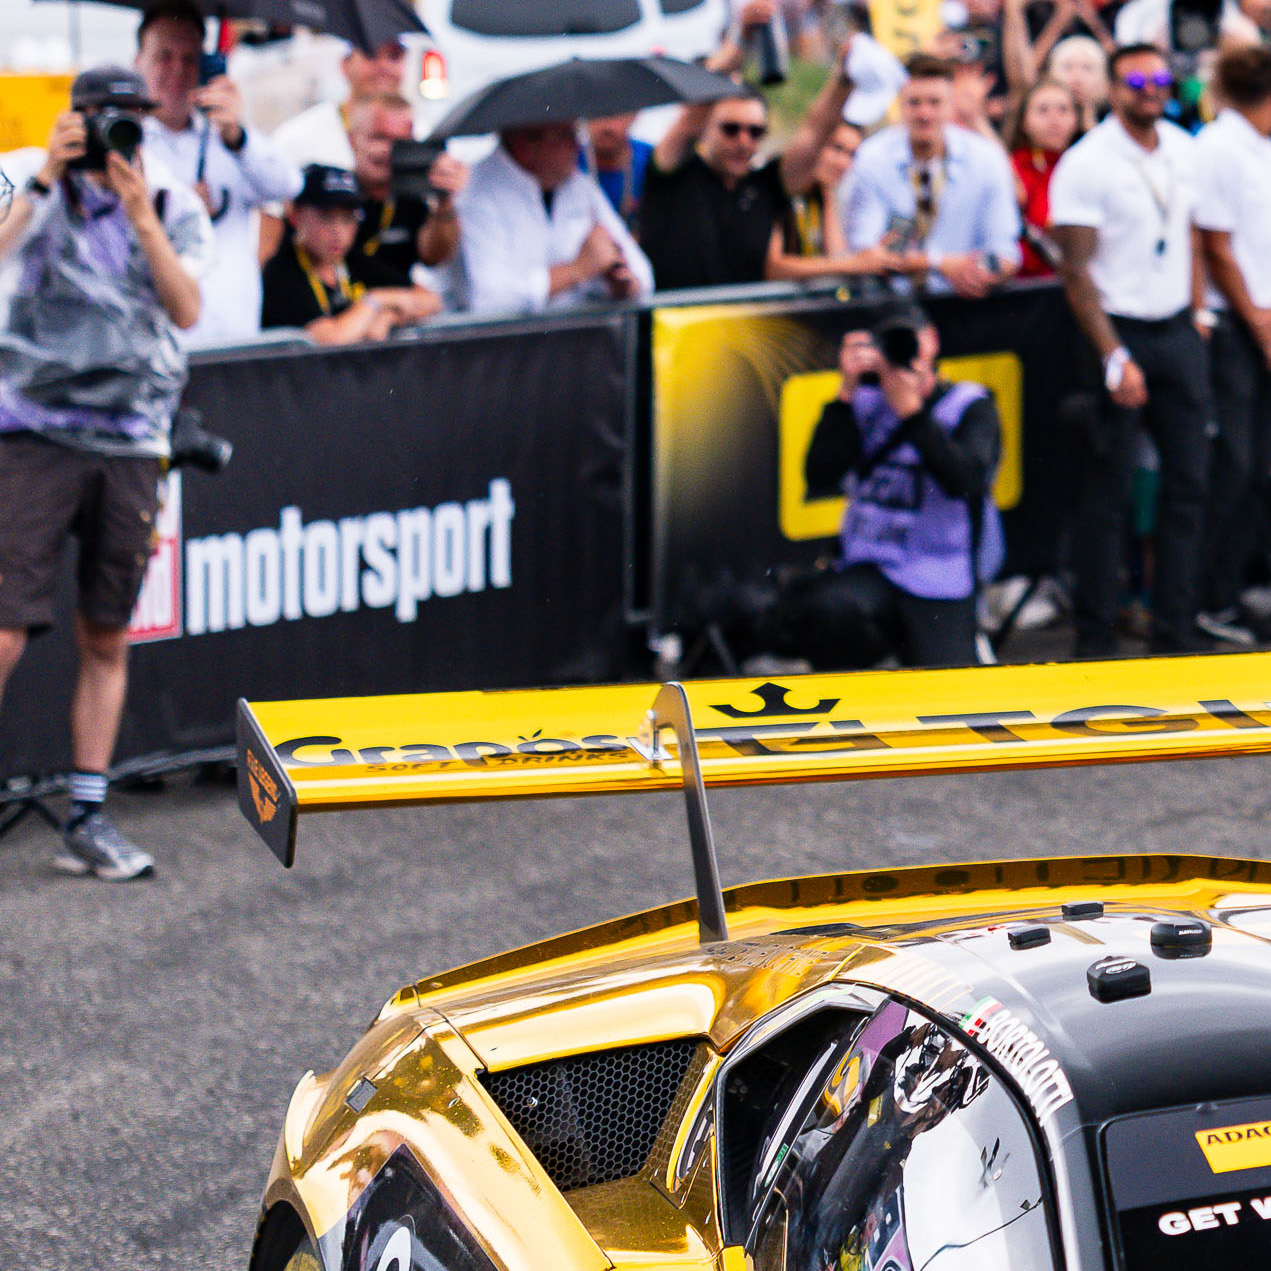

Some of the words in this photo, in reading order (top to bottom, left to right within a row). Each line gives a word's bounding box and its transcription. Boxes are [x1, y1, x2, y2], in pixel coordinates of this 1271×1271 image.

[185, 478, 516, 637] motorsport
[915, 699, 1270, 744] TGI
[496, 750, 629, 768] DRINKS
[977, 1007, 1076, 1128] BORTOLOTTI
[1156, 1201, 1243, 1238] GET
